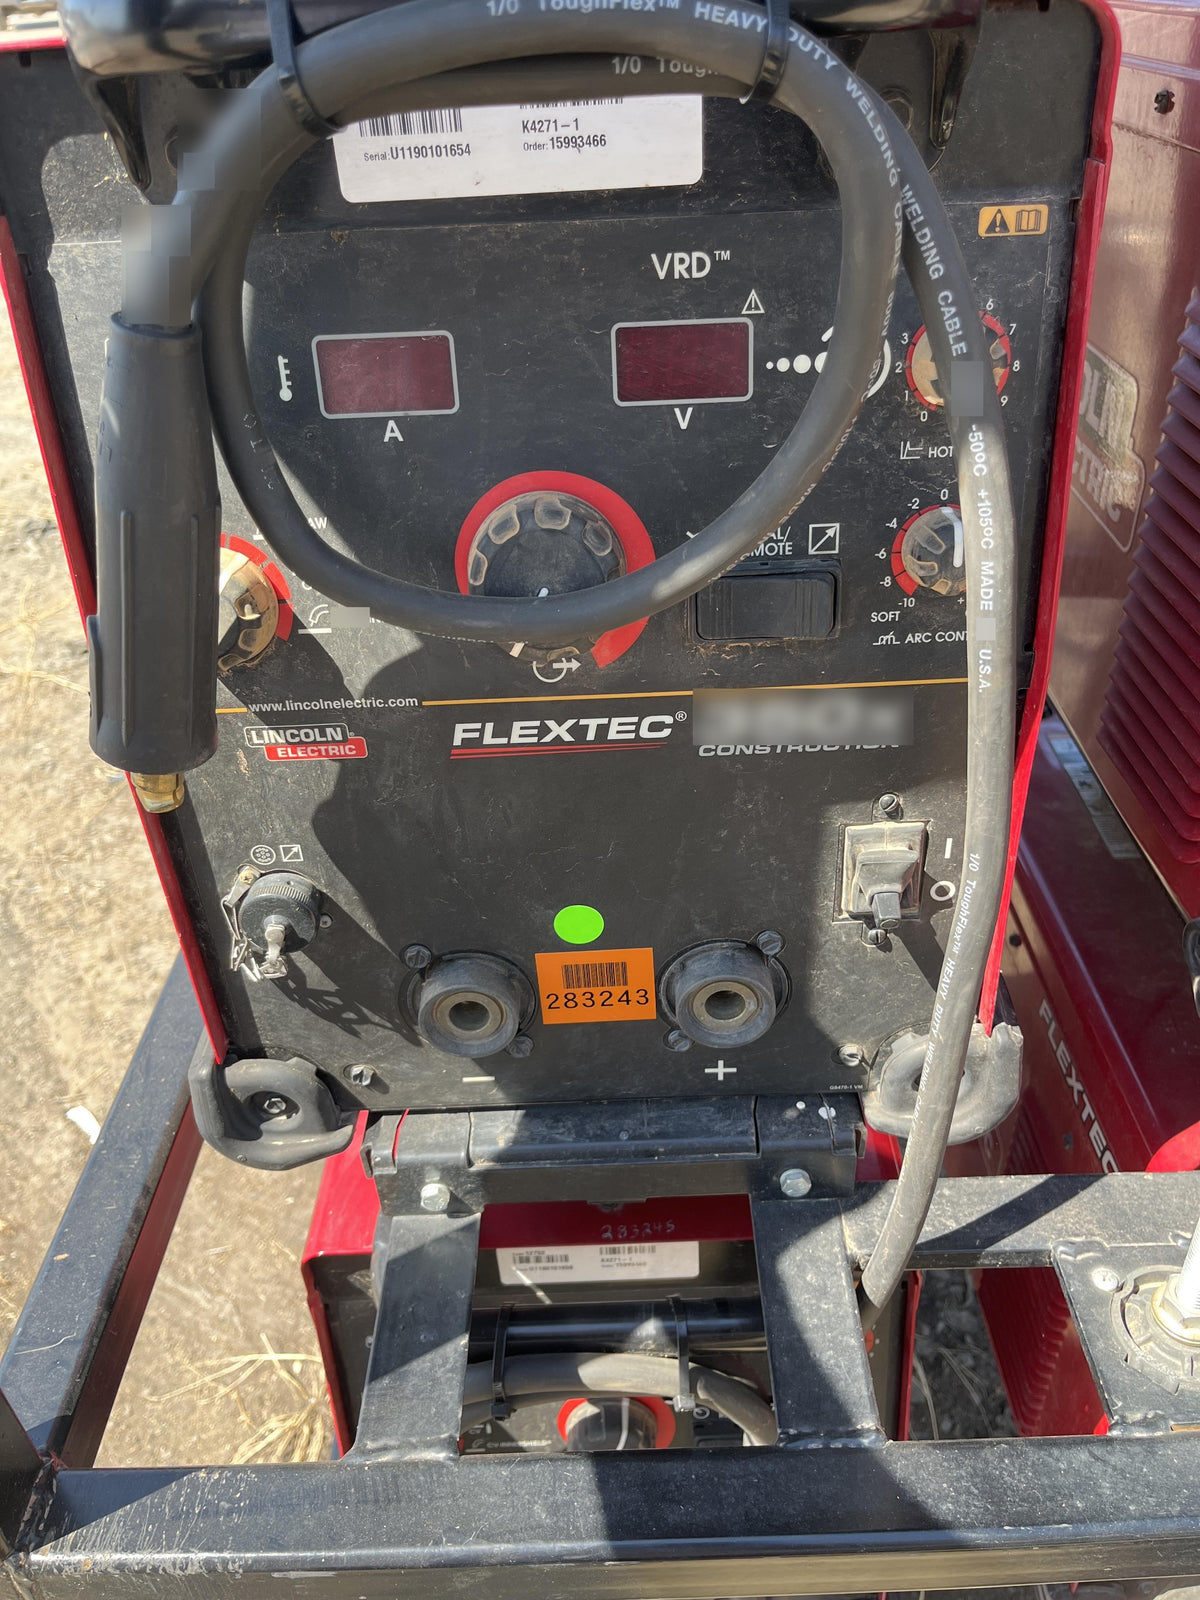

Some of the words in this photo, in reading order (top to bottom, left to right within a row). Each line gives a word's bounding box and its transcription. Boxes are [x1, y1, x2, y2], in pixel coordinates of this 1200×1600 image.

[611, 56, 642, 75] 1/0
[487, 2, 519, 16] 1/0
[694, 4, 767, 33] HEAVY
[845, 77, 900, 188] WELDING
[901, 184, 944, 280] WELDING
[985, 298, 994, 311] 6
[938, 290, 968, 357] CABLE
[1009, 323, 1017, 336] 7
[901, 332, 909, 345] 3
[895, 361, 903, 373] 2
[1012, 360, 1020, 372] 8
[904, 390, 909, 402] 1
[1000, 395, 1008, 407] 9
[674, 407, 693, 430] V
[920, 411, 928, 422] 0
[383, 419, 404, 443] A
[940, 489, 949, 500] 0
[907, 499, 920, 510] -2
[885, 518, 898, 529] -4
[874, 548, 887, 560] -6
[879, 576, 892, 588] -8
[980, 561, 994, 611] MADE
[898, 597, 916, 608] -10
[871, 611, 900, 623] SOFT
[904, 633, 932, 645] ARC
[978, 649, 992, 693] U.S.A.
[248, 696, 419, 712] www.lincolnelectric.com
[277, 744, 357, 758] ELECTRIC
[968, 852, 981, 872] 1/0
[938, 957, 957, 1000] HEAVY
[546, 988, 649, 1010] 283243
[932, 1003, 944, 1038] DUTY
